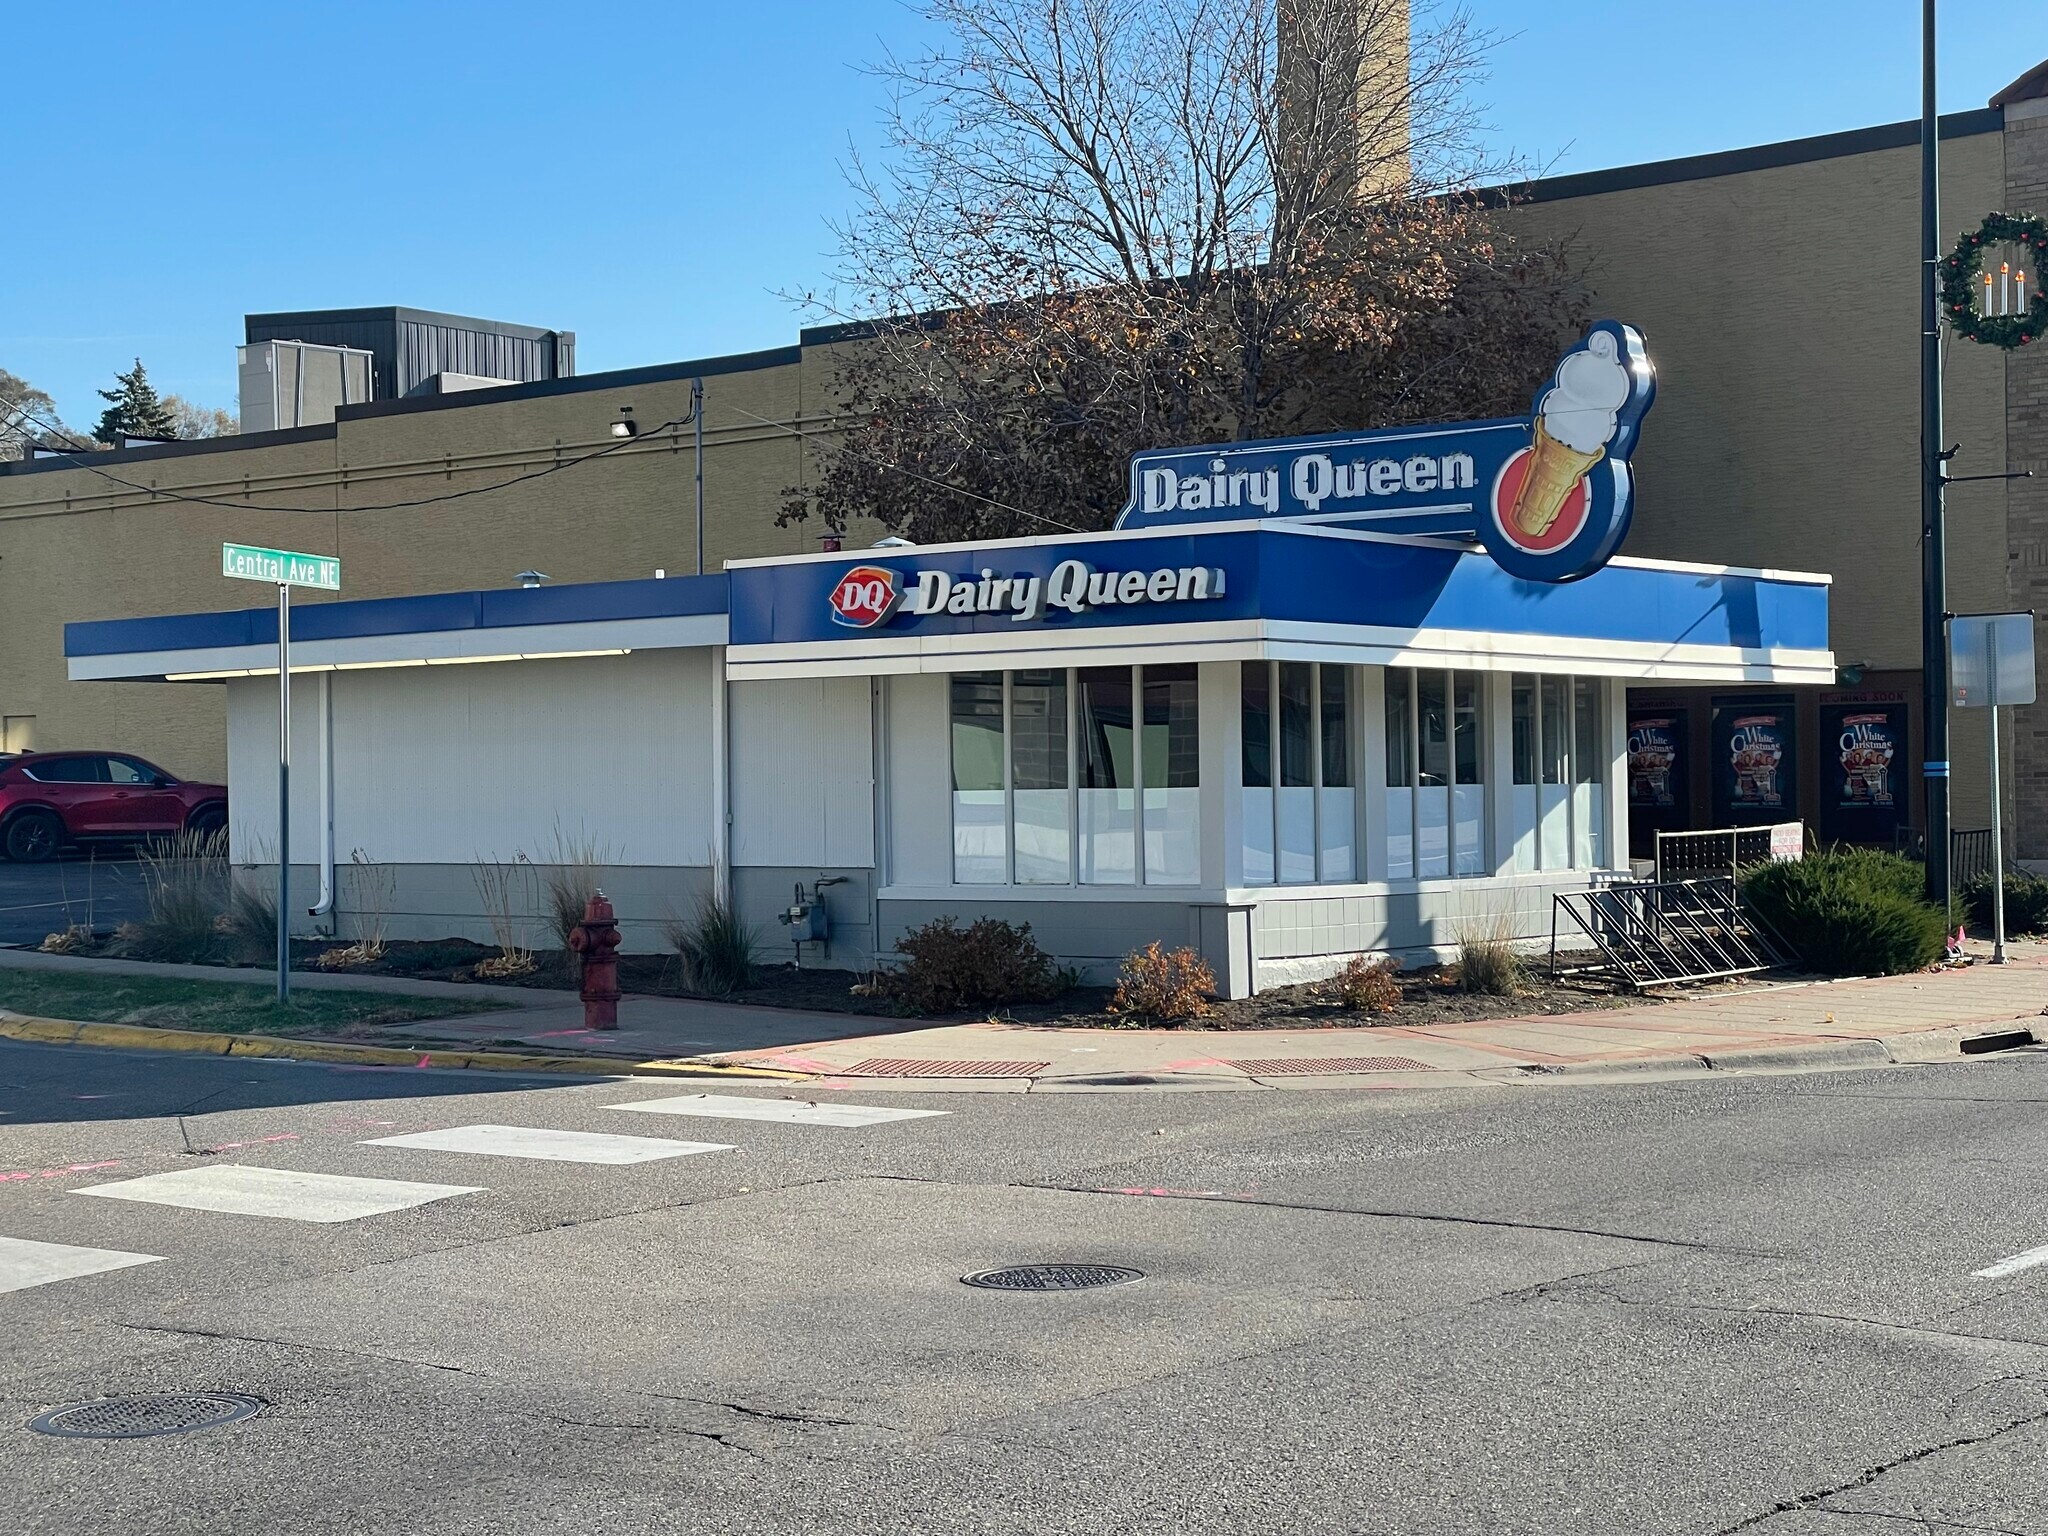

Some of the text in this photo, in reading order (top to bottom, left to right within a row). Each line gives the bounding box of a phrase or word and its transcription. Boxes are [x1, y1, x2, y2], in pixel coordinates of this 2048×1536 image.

[1141, 453, 1475, 514] Dairy Queen
[227, 548, 336, 585] Central Ave NE
[841, 581, 884, 612] DQ
[913, 559, 1211, 622] Dairy Queen
[1640, 728, 1668, 745] White
[1744, 726, 1774, 743] White
[1839, 732, 1892, 752] Christmas
[1854, 724, 1886, 742] White
[1627, 736, 1674, 755] Christmas
[1730, 734, 1781, 753] Christmas
